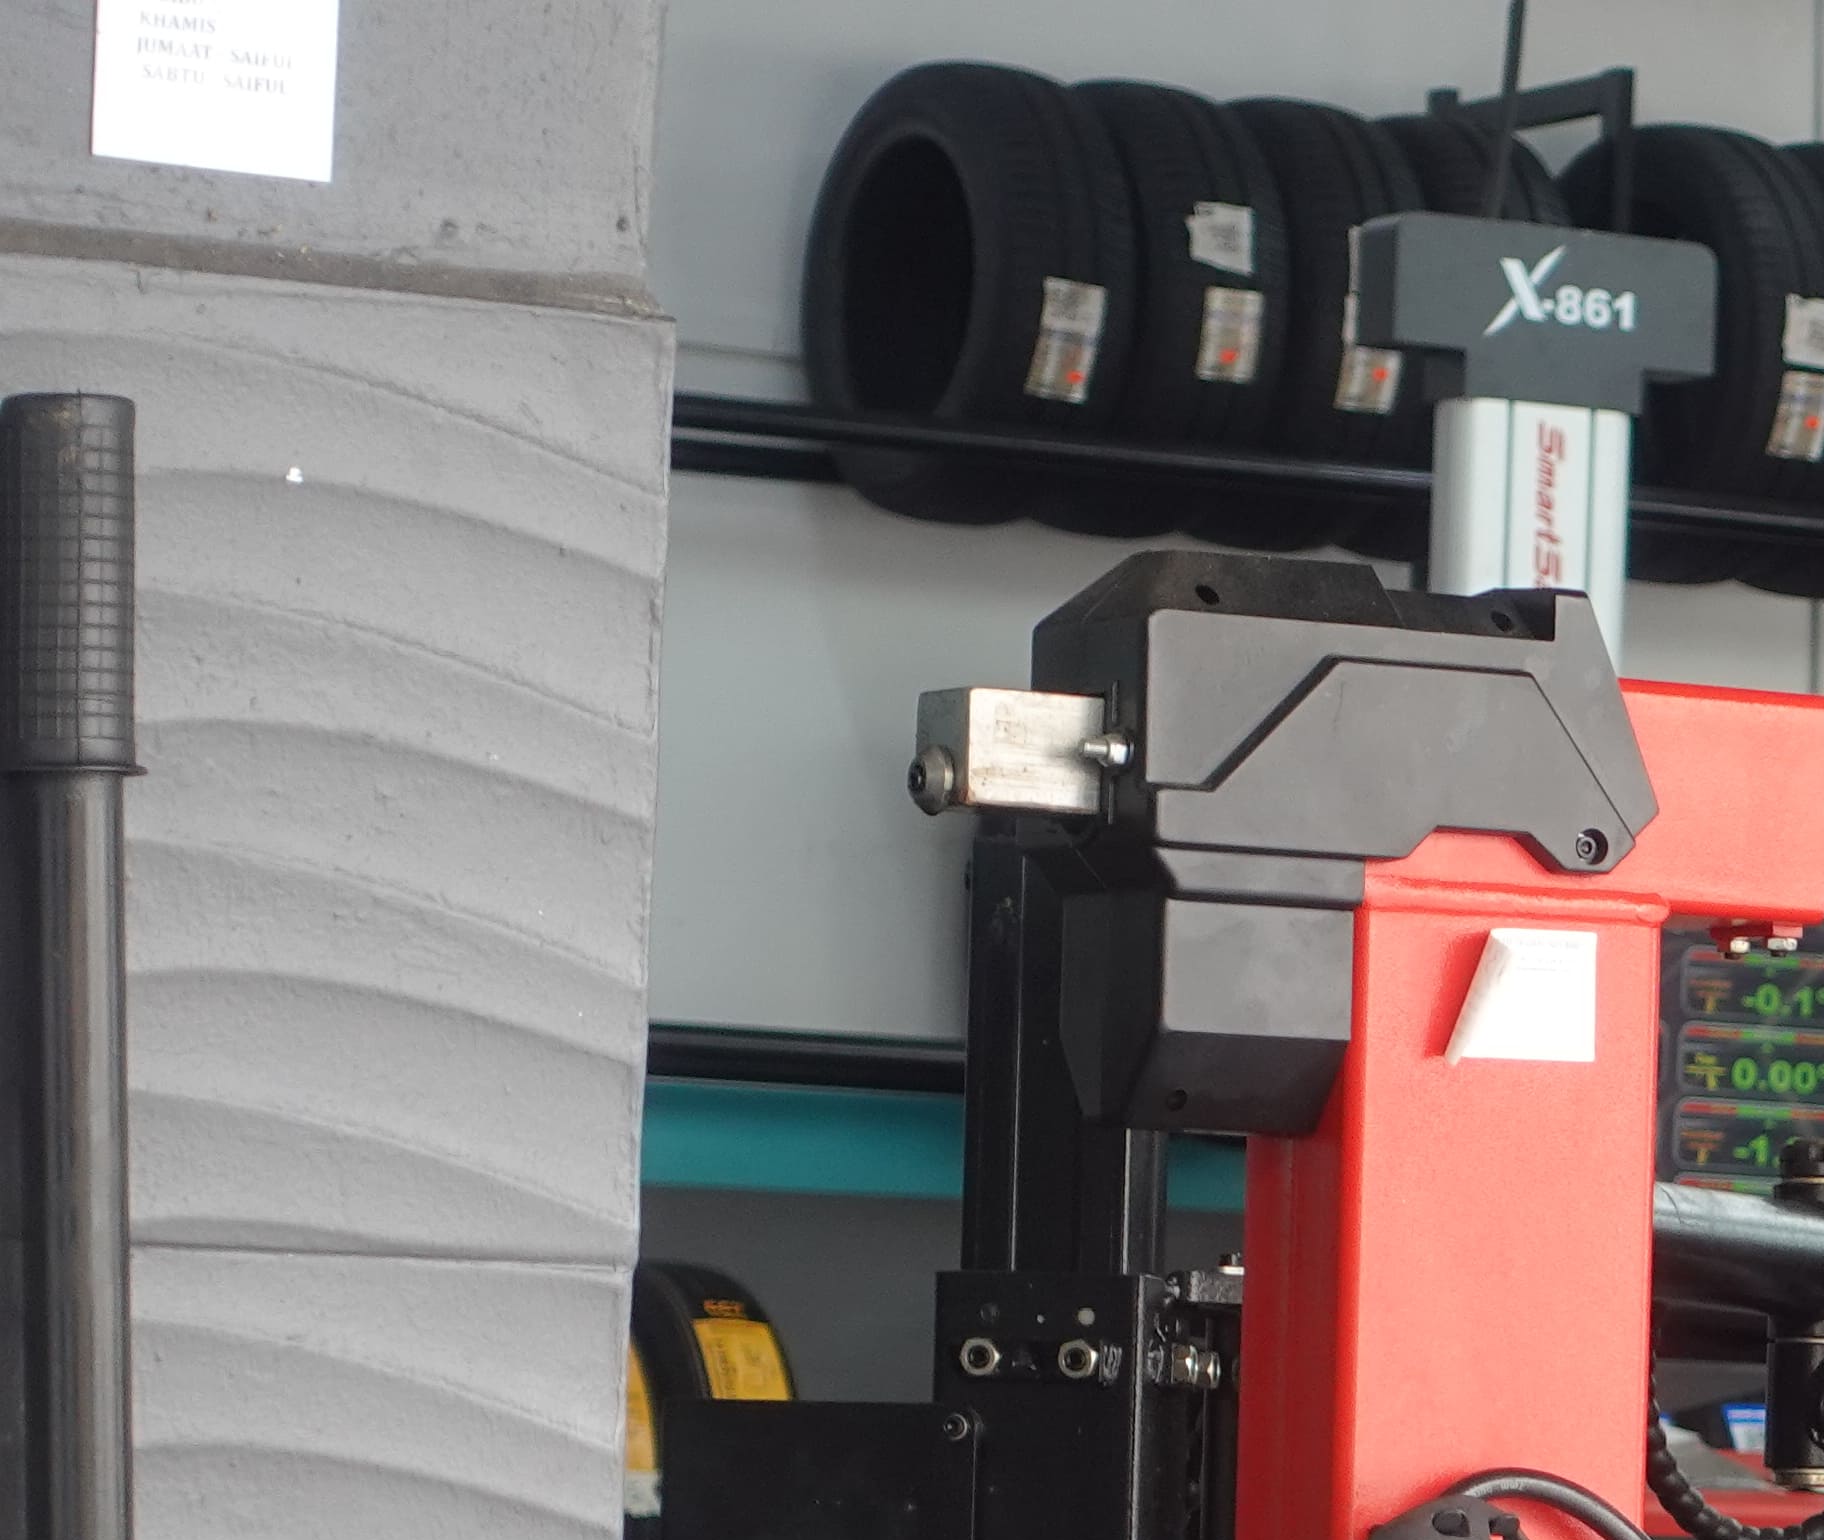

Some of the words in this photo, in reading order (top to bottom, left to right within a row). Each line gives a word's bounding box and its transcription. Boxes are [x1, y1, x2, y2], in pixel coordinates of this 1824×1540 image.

[139, 10, 217, 34] KHAMIS
[136, 36, 213, 60] JUMAAT
[141, 63, 206, 85] SABTU
[1482, 244, 1637, 336] X-861
